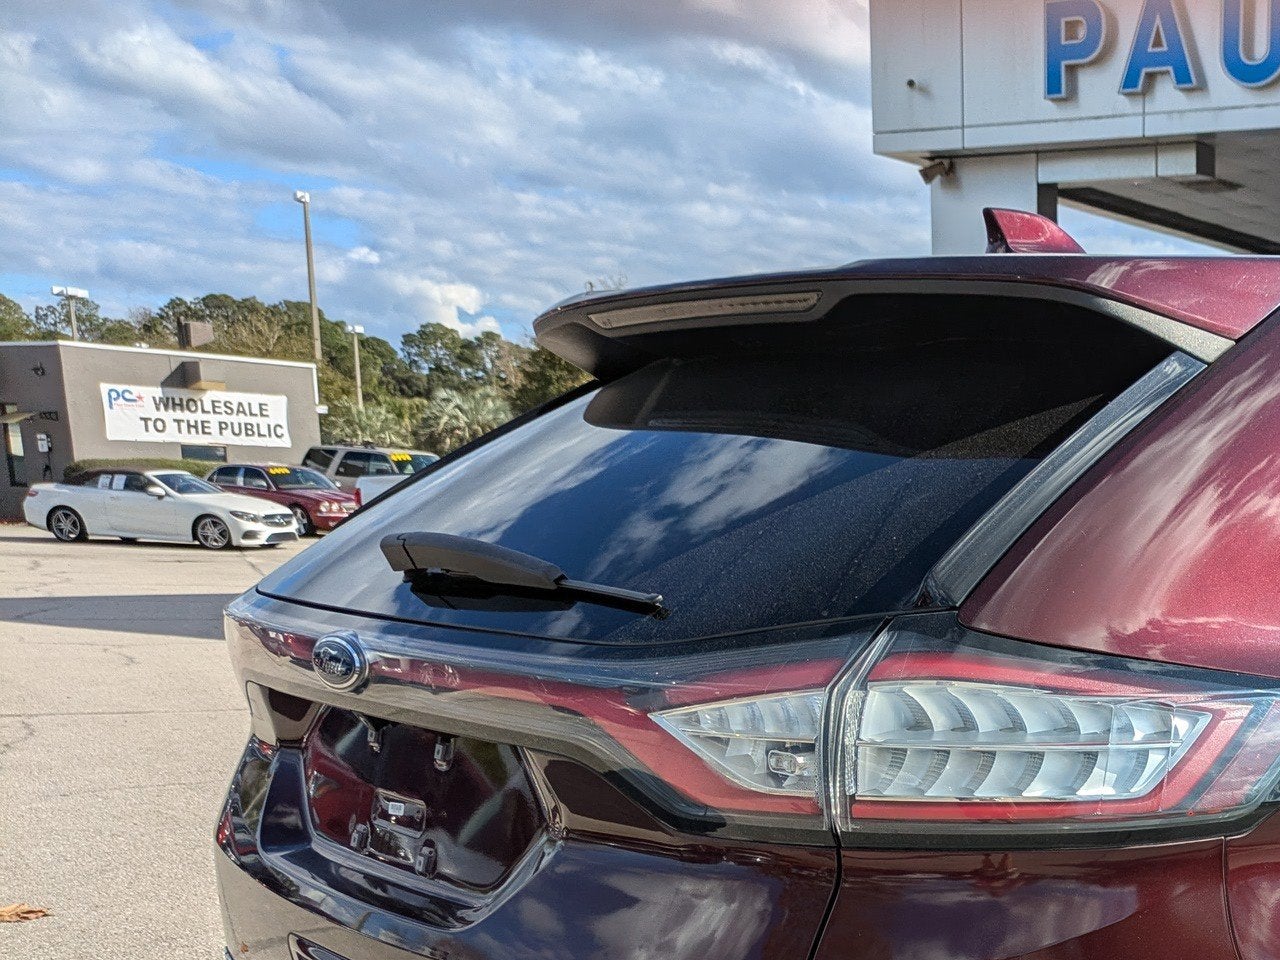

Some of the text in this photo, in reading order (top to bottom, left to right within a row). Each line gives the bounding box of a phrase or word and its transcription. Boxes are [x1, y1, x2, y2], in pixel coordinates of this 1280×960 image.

[152, 396, 270, 418] WHOLESALE
[139, 417, 285, 439] TO THE PUBLIC
